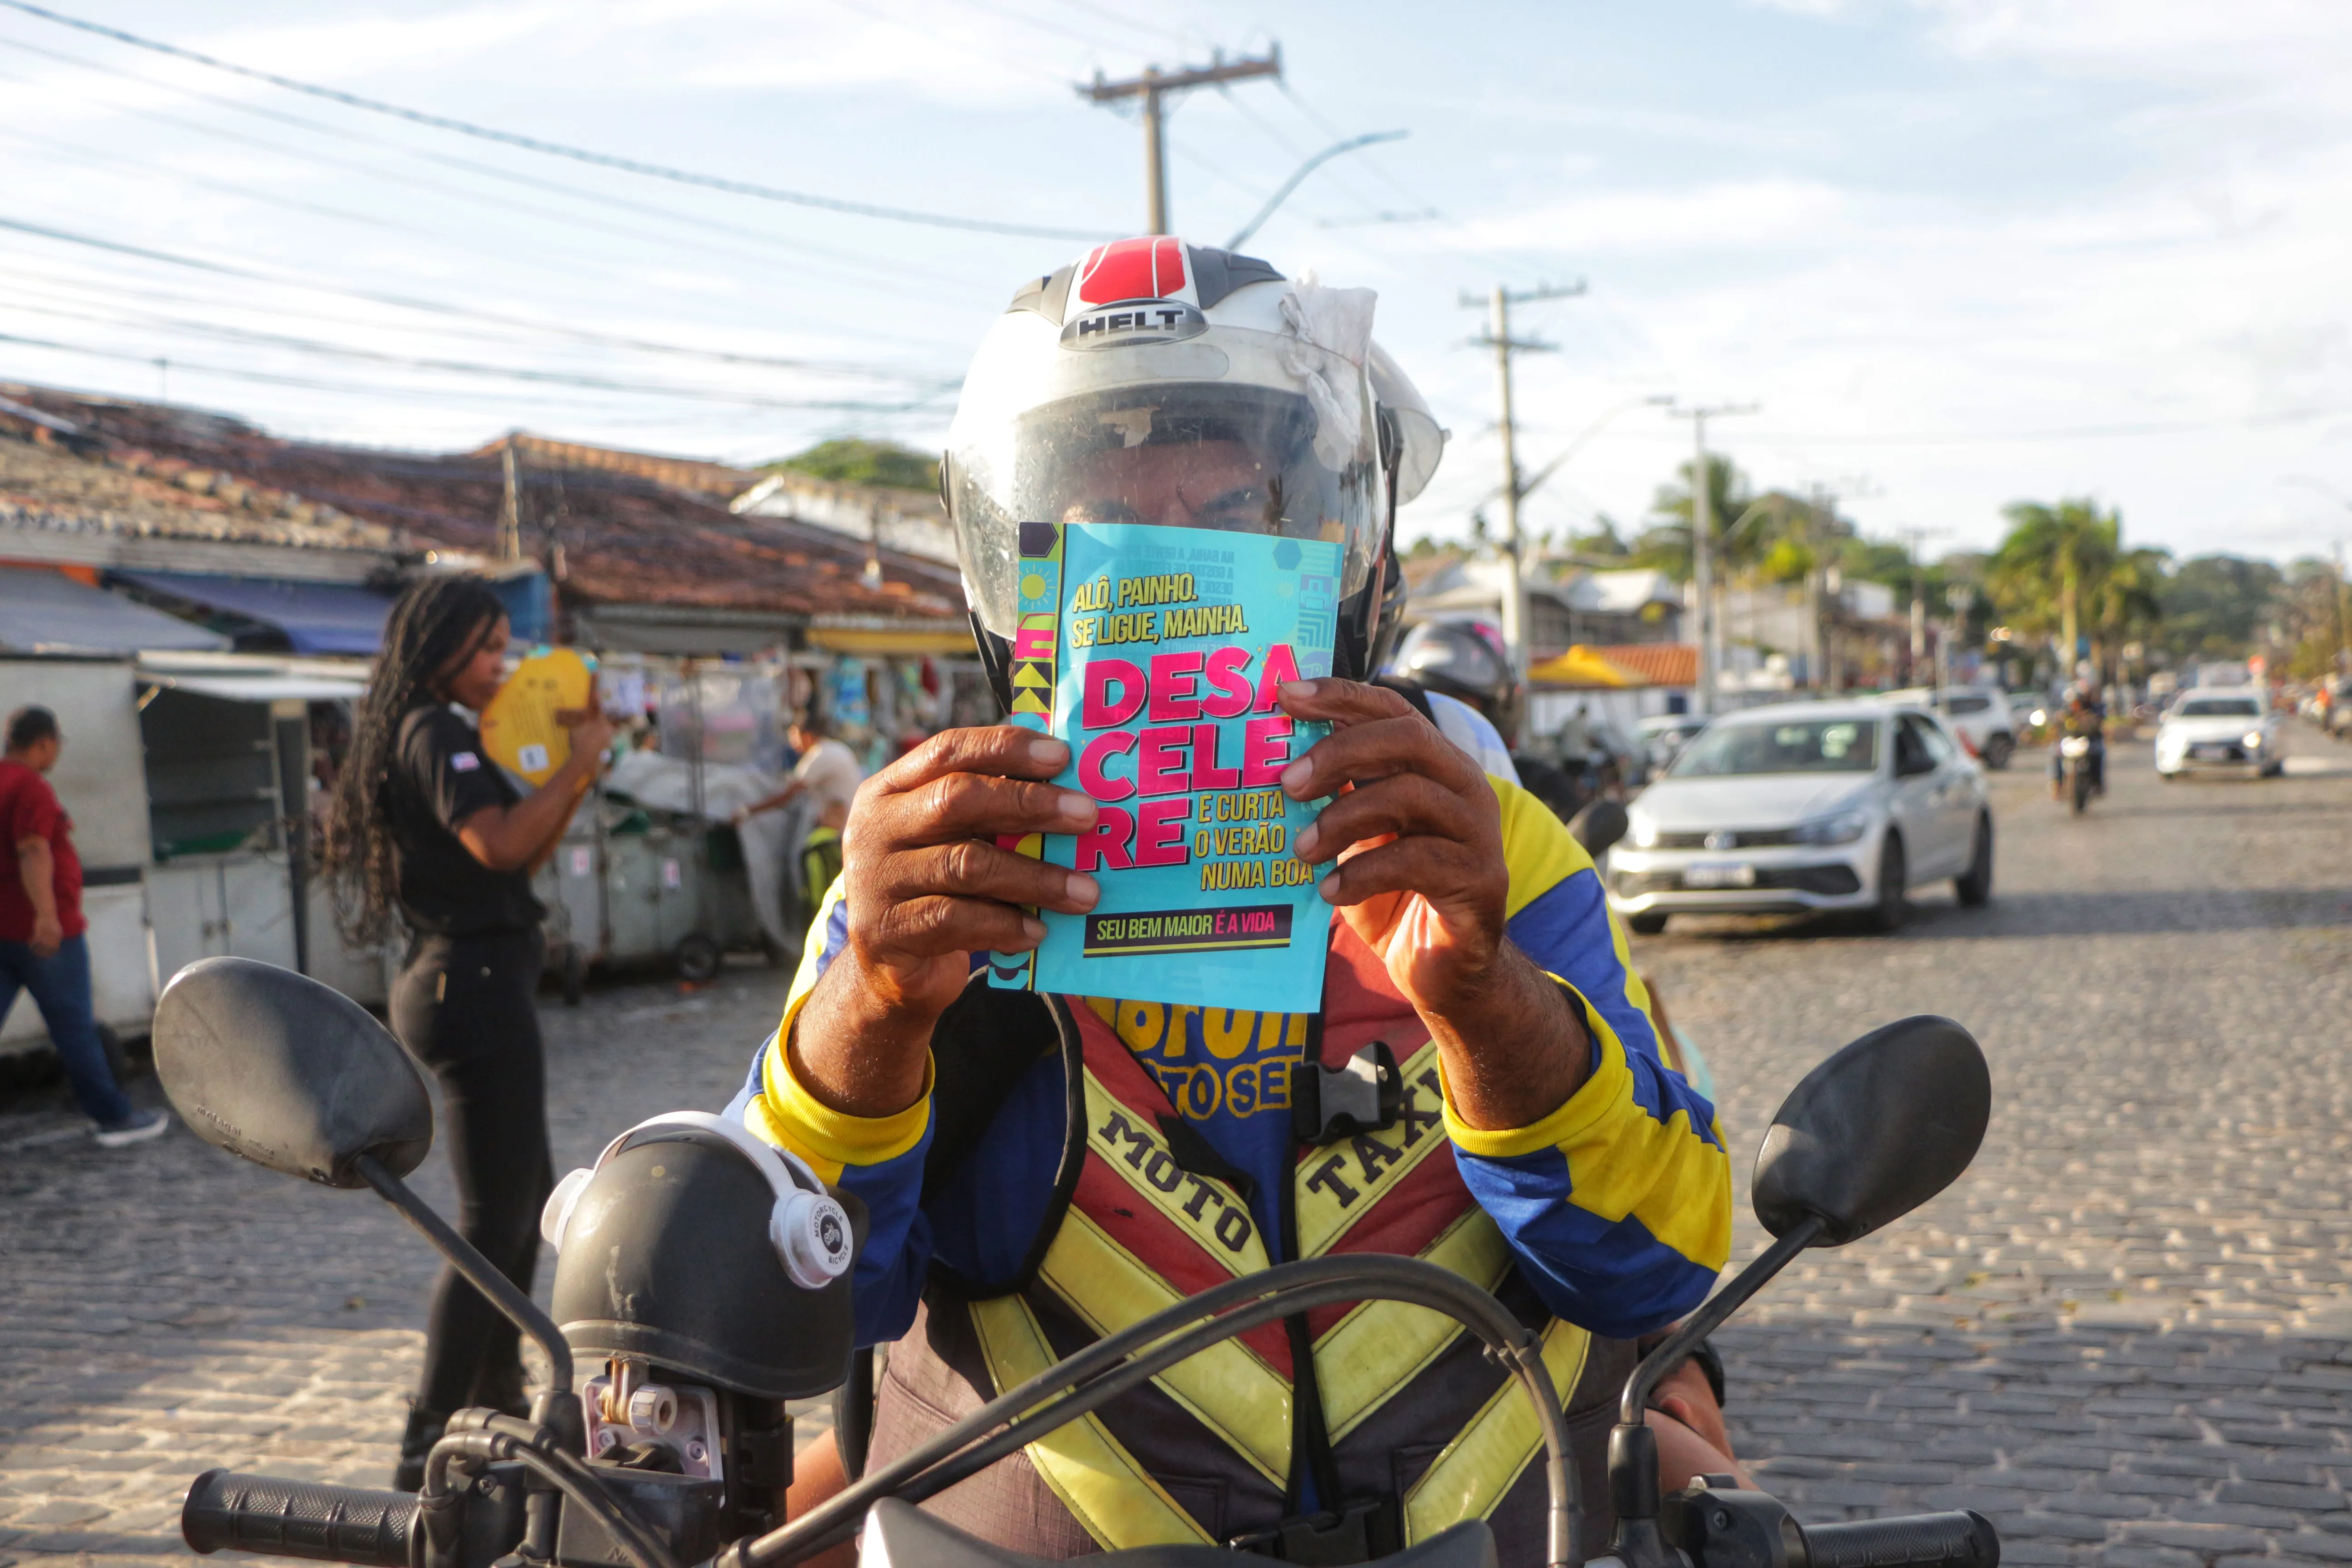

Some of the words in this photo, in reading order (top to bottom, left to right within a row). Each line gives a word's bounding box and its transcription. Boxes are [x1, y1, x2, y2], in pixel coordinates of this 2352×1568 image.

[1078, 310, 1185, 341] HELT
[1073, 575, 1114, 612] ALÔ,
[1117, 573, 1199, 608] PAINHO.
[1071, 617, 1095, 648] SE
[1097, 612, 1160, 645] LIGUE,
[1162, 604, 1249, 639] MAINHA.
[1082, 643, 1303, 730] DESA
[1077, 716, 1295, 803] CELE
[1198, 794, 1214, 823] E
[1216, 790, 1286, 822] CURTA
[1074, 796, 1194, 872] RE
[1195, 829, 1210, 858] O
[1214, 821, 1286, 856] VERÃO
[1201, 860, 1265, 892] NUMA
[1270, 858, 1314, 888] BOA
[1097, 917, 1126, 941] SEU
[1128, 916, 1163, 940] BEM
[1165, 914, 1212, 937] MAIOR
[1215, 911, 1225, 935] É
[1227, 913, 1238, 934] A
[1241, 911, 1275, 933] VIDA
[1307, 1067, 1444, 1208] TAXI
[1098, 1110, 1252, 1252] MOTO
[814, 1204, 843, 1237] MOTORCYCLE
[828, 1243, 848, 1264] BICYCLE
